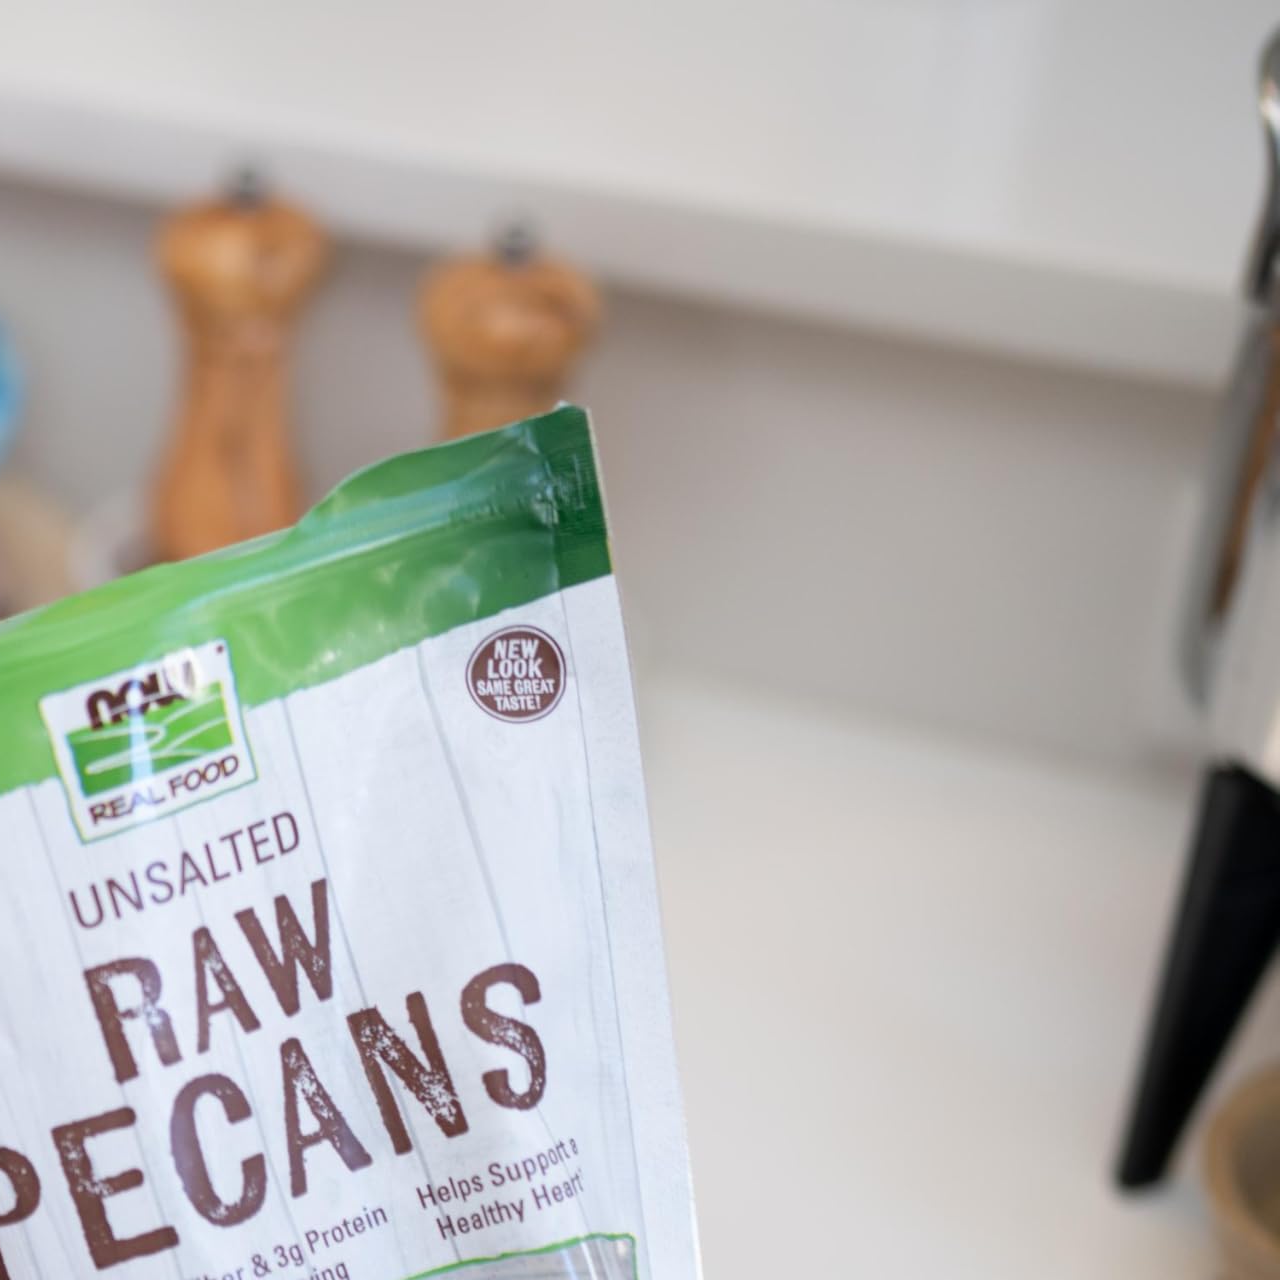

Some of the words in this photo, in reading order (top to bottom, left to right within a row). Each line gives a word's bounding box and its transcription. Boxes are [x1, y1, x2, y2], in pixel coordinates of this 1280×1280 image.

[487, 658, 543, 679] LOOK
[494, 638, 539, 660] NEW
[477, 679, 512, 697] SAME
[514, 679, 555, 695] GREAT
[495, 695, 542, 711] TASTE!
[89, 786, 165, 825] REAL
[168, 755, 239, 797] FOOD
[69, 812, 300, 929] UNSALTED
[84, 877, 333, 1084] RAW
[416, 1175, 484, 1209] Helps
[488, 1140, 570, 1189] Support
[251, 1252, 272, 1279] &
[273, 1242, 305, 1268] 3g
[305, 1205, 389, 1253] Protein
[436, 1199, 524, 1240] Healthy
